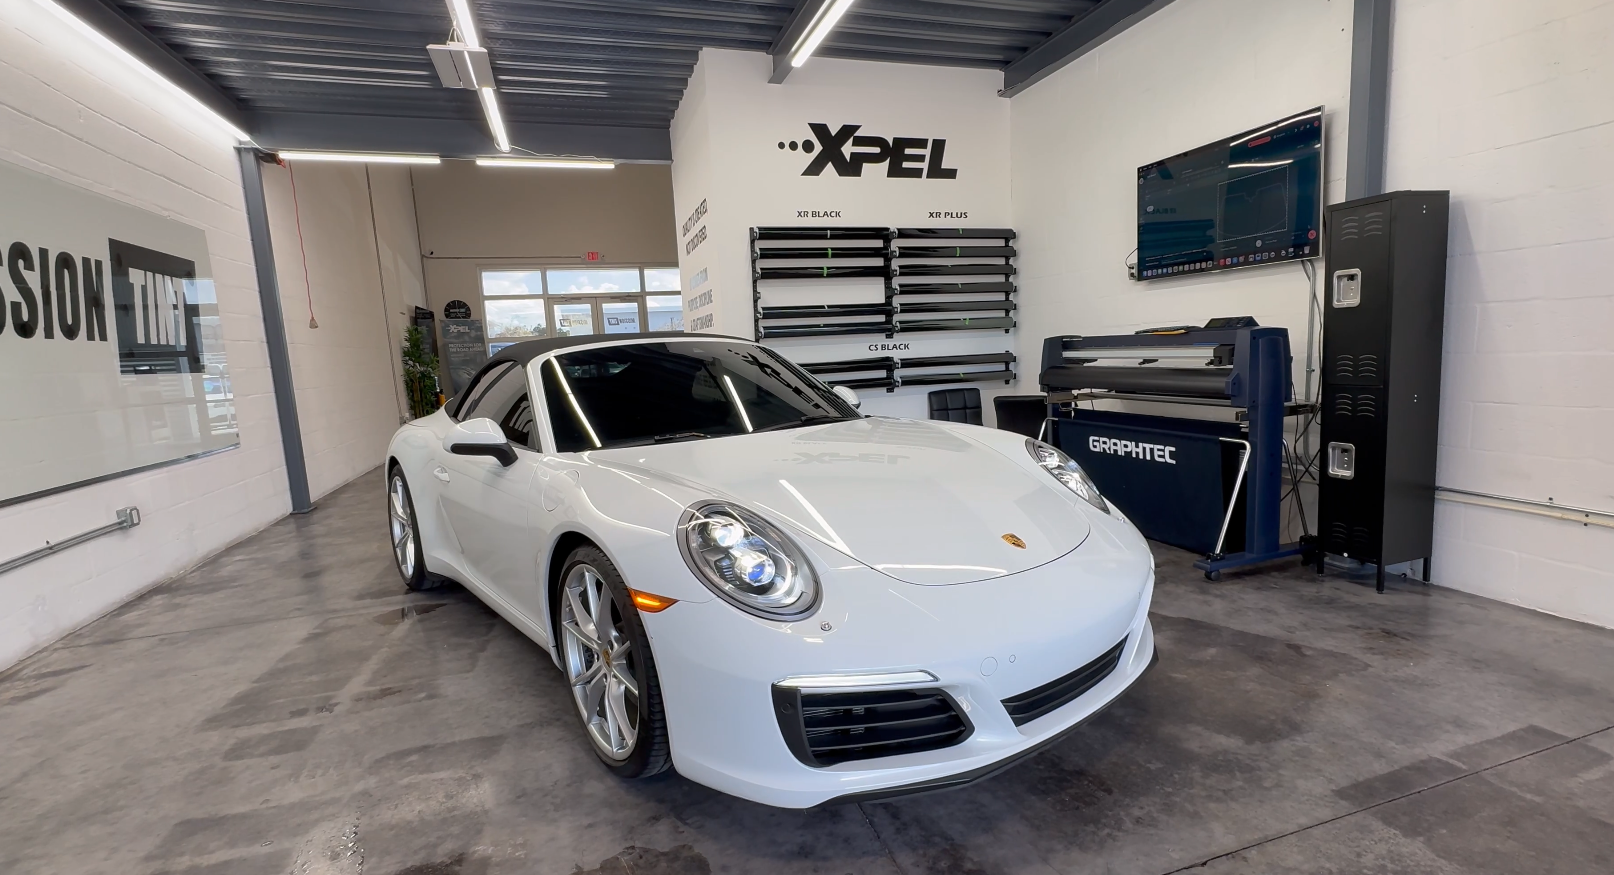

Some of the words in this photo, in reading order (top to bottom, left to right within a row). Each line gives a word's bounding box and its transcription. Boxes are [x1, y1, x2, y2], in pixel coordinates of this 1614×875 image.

[800, 122, 958, 179] XPEL
[797, 210, 809, 218] XR
[811, 210, 842, 218] BLACK
[928, 211, 942, 219] XR
[944, 211, 968, 219] PLUS
[0, 241, 108, 342] SION
[128, 267, 188, 346] TINT
[449, 325, 470, 333] XPEL
[881, 343, 910, 351] BLACK
[1088, 435, 1176, 464] GRAPHTEC
